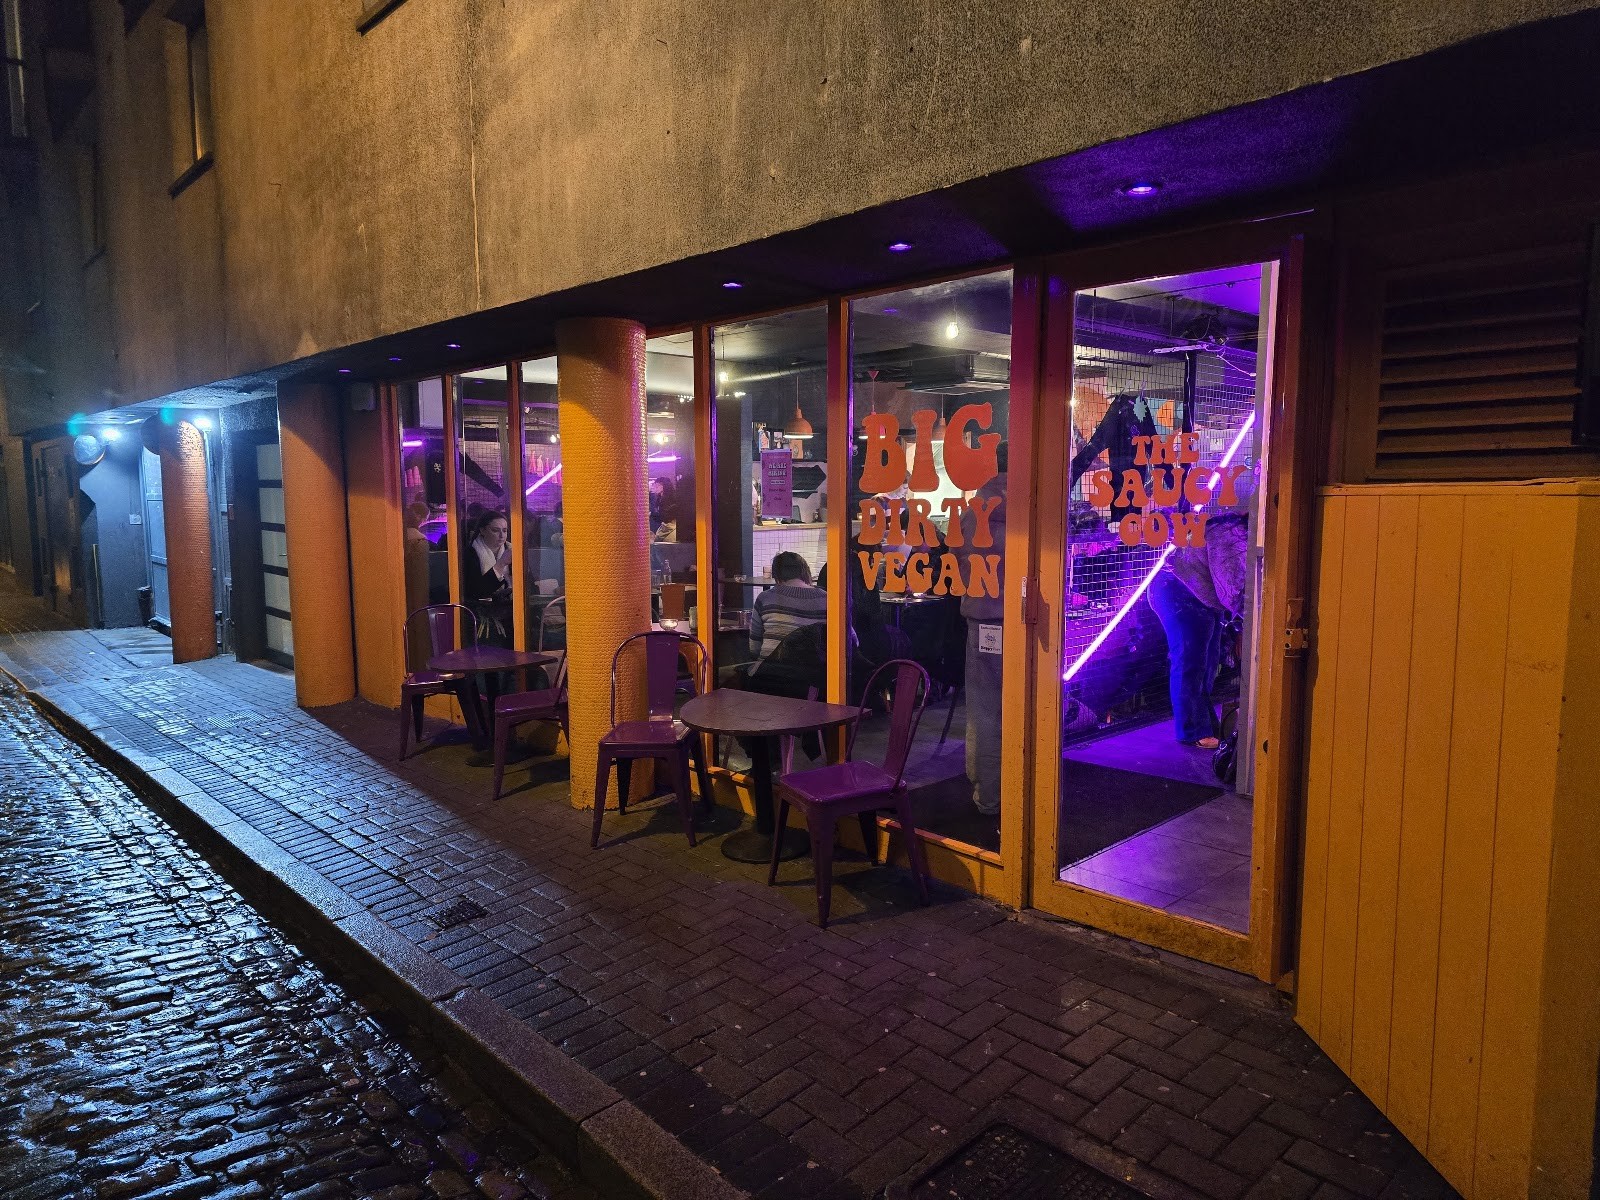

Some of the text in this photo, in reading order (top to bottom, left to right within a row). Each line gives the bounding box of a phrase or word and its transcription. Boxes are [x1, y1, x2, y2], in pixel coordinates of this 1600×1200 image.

[858, 402, 1001, 493] BIG
[1131, 432, 1199, 465] THE
[1088, 465, 1247, 508] SAUCY
[858, 496, 1002, 548] DIRTY
[1119, 512, 1209, 548] COW
[858, 551, 1001, 598] VEGAN
